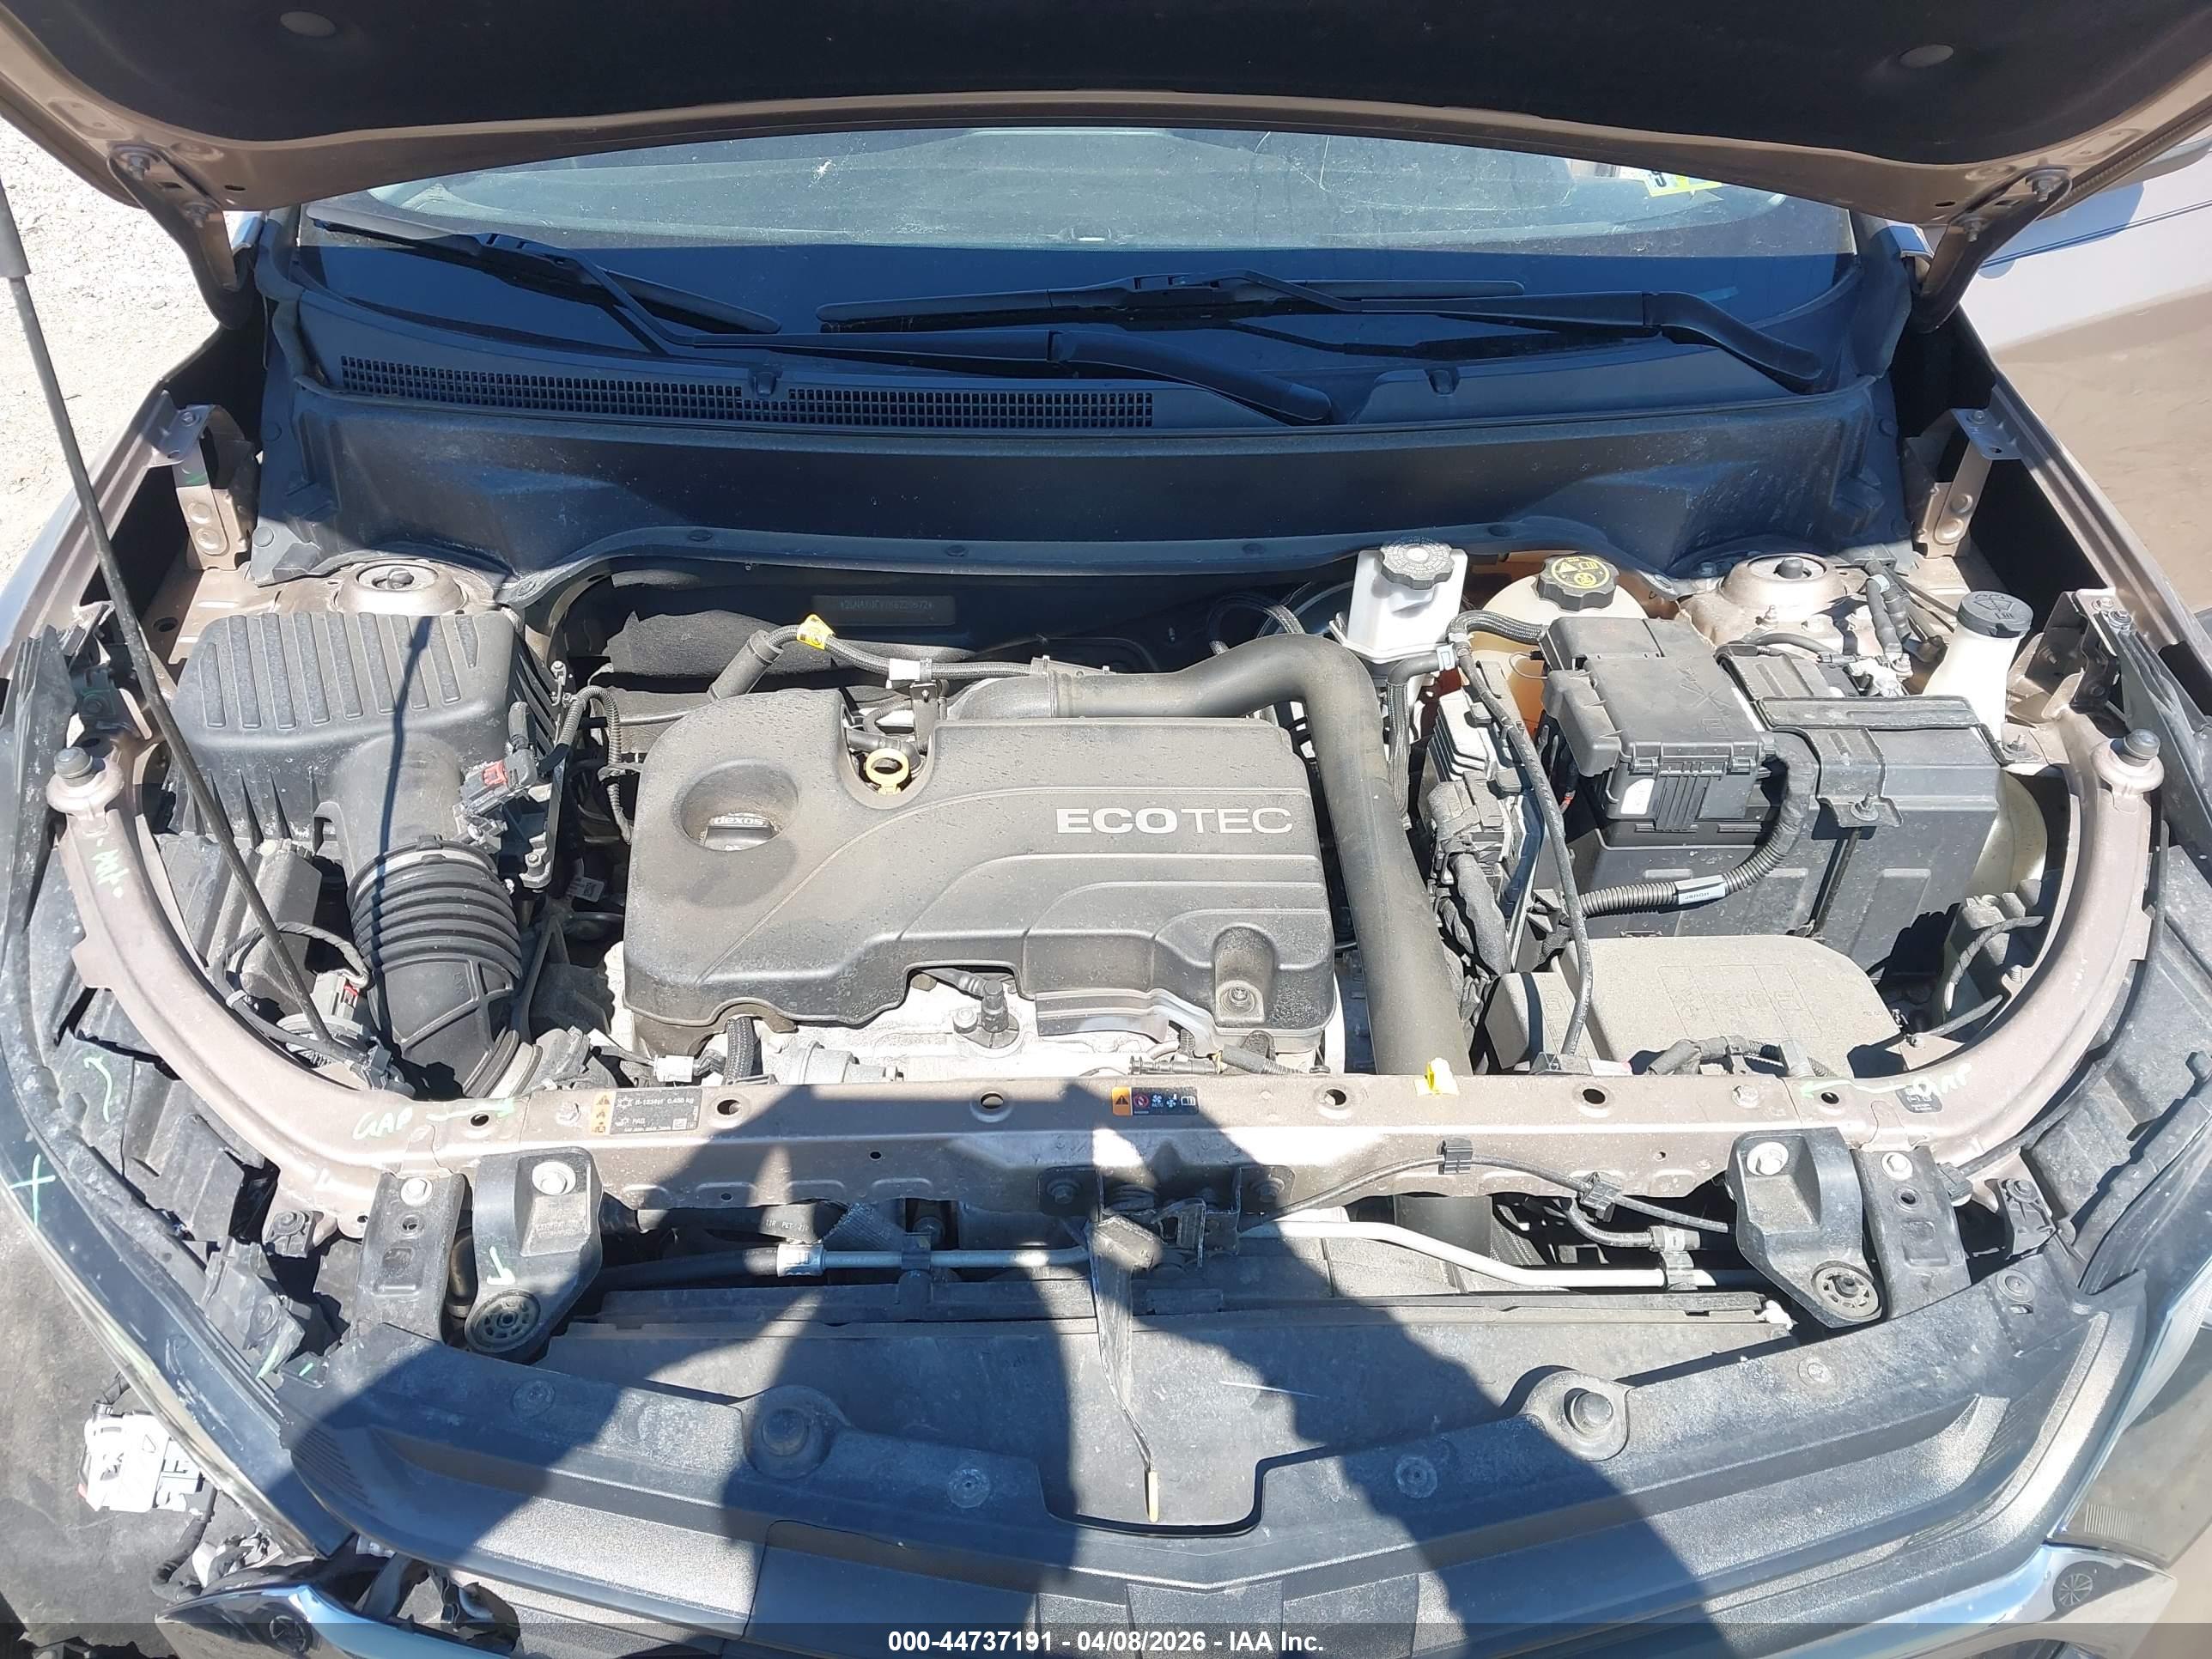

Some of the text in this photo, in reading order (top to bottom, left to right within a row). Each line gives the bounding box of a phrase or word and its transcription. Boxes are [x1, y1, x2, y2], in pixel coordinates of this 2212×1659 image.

[714, 816, 763, 826] dexos
[1056, 807, 1293, 834] ECOTEC
[352, 1107, 413, 1141] GAP
